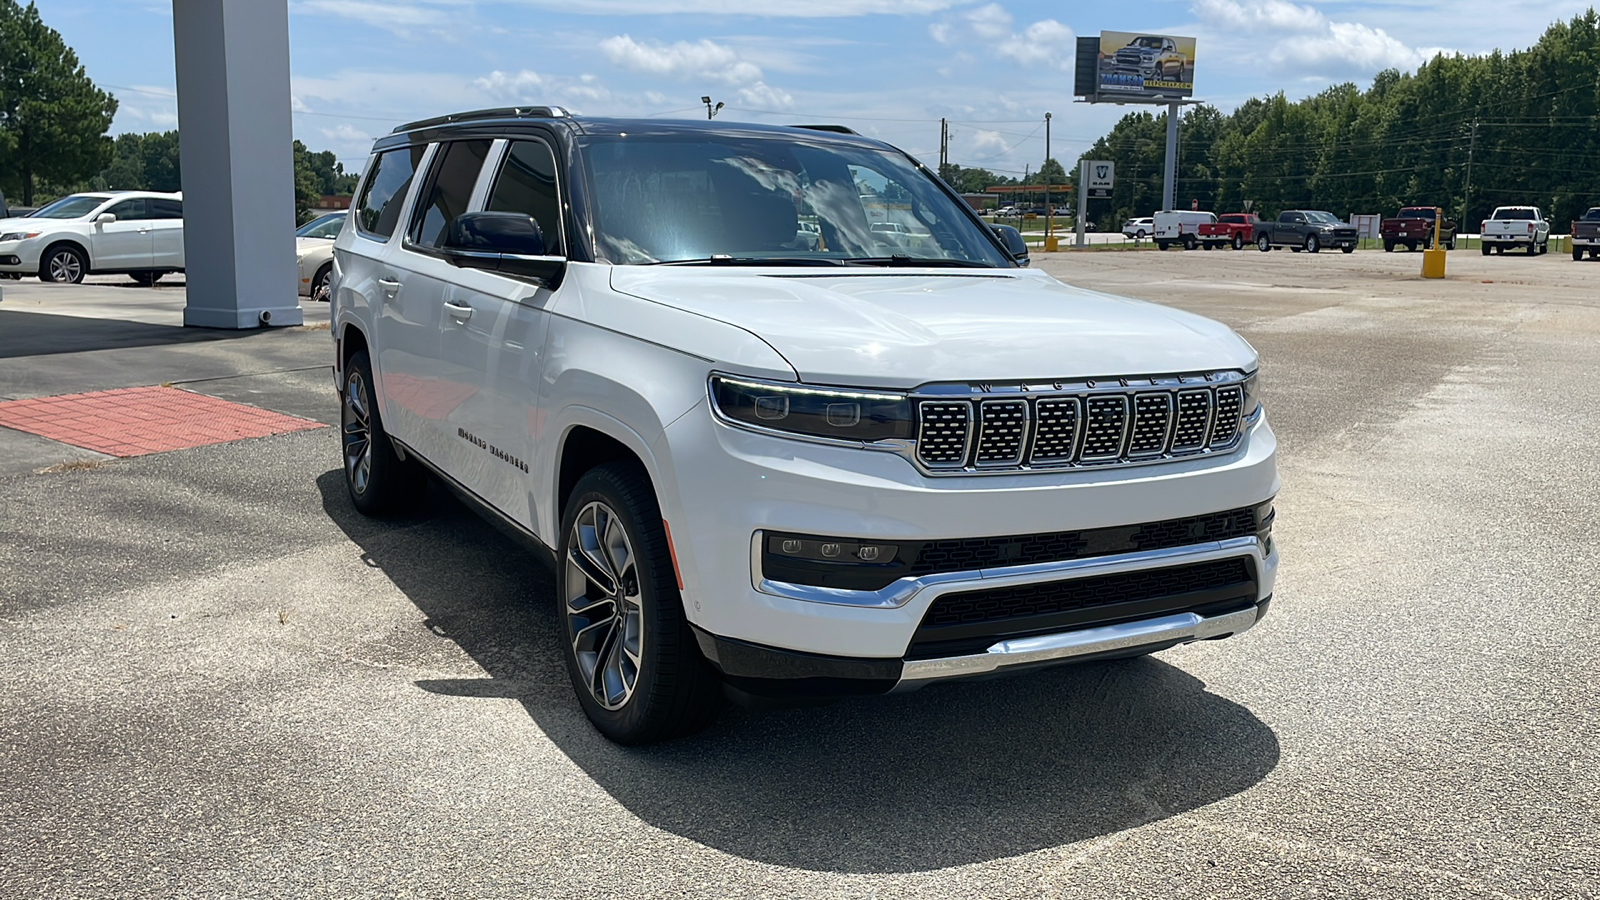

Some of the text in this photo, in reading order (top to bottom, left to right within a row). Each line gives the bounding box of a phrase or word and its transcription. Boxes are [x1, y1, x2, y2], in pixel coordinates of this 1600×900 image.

[1101, 74, 1144, 86] THOMSON
[979, 372, 1213, 393] WAGONEER
[489, 444, 529, 474] WAGONEER
